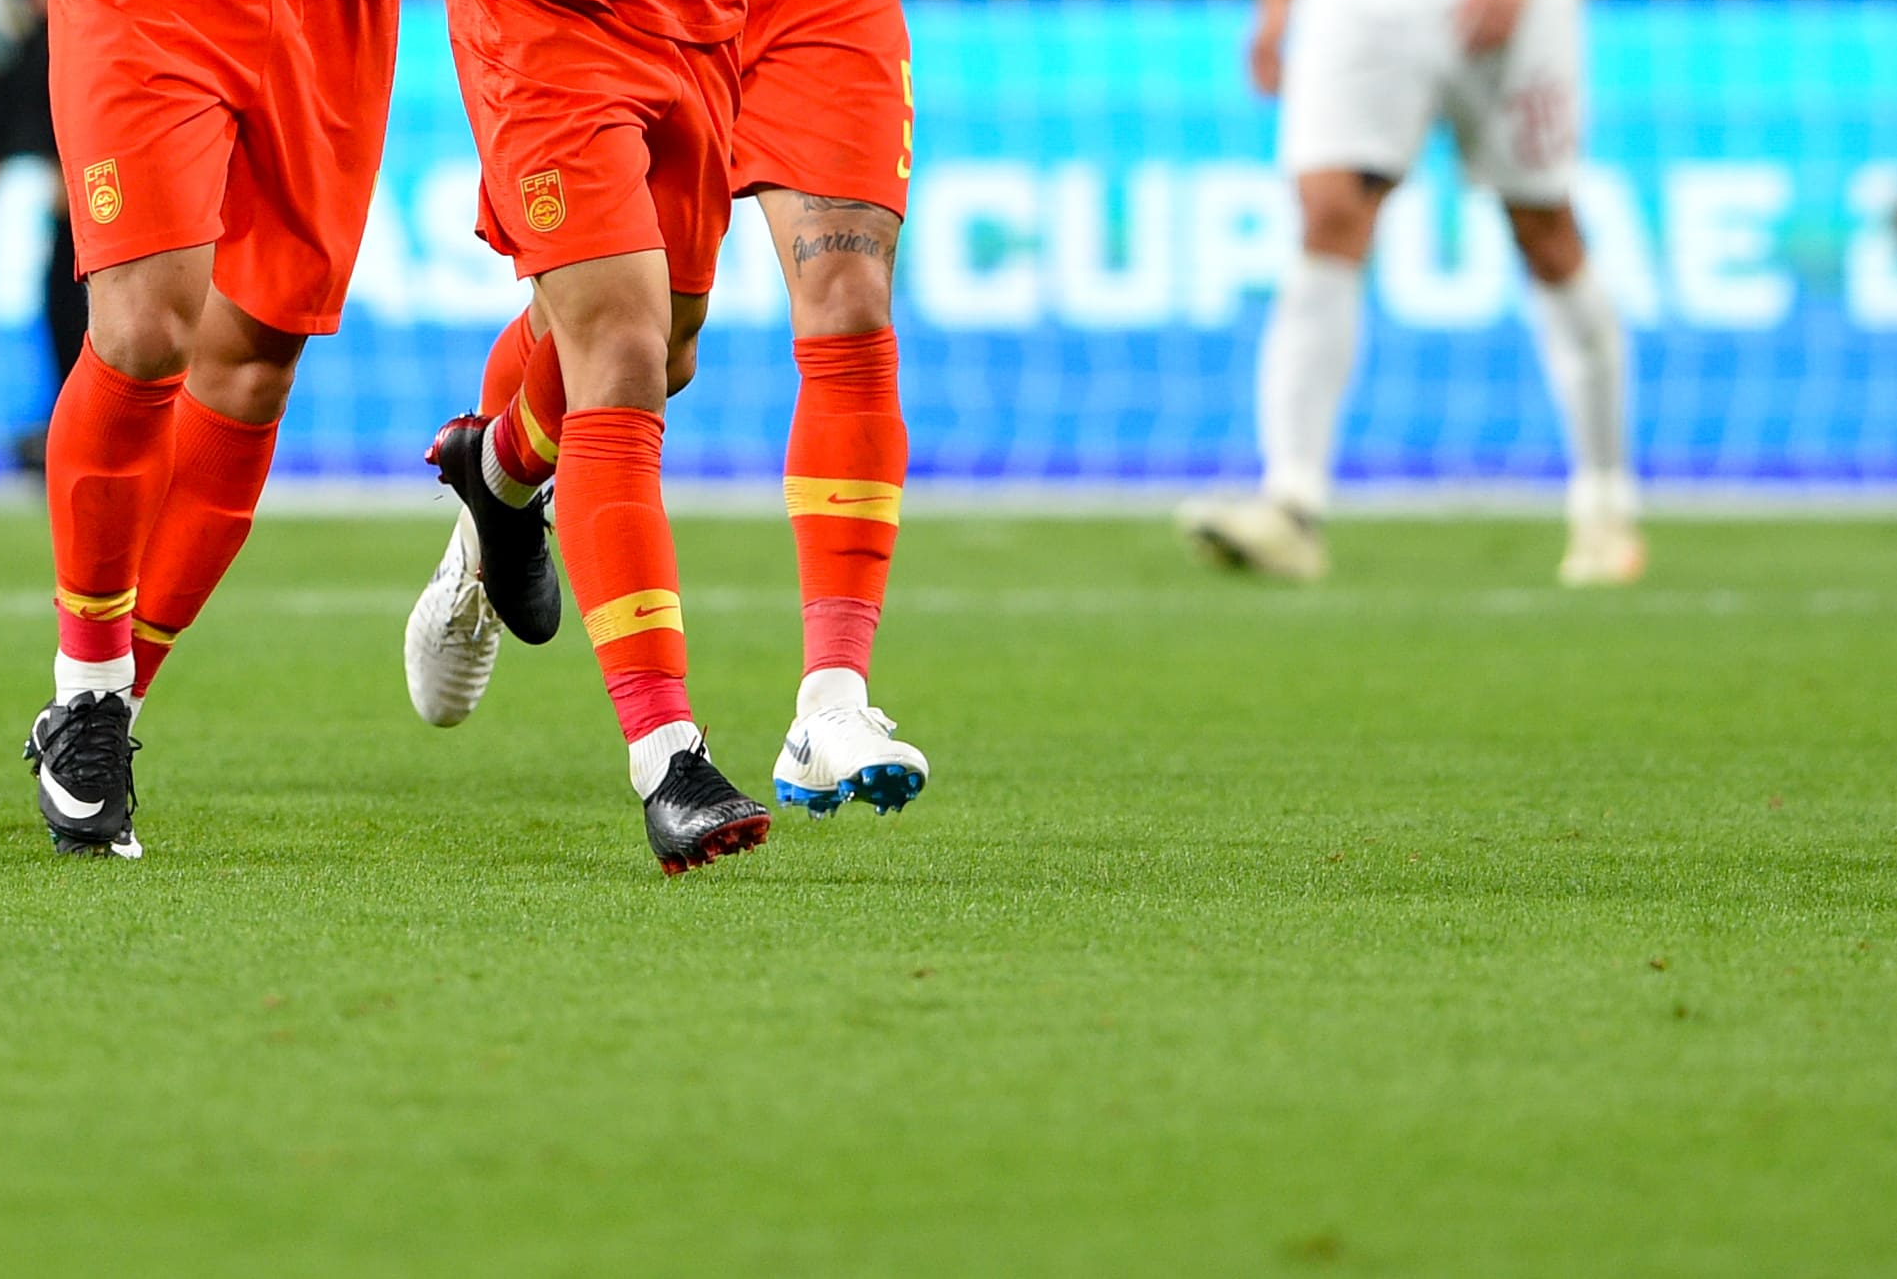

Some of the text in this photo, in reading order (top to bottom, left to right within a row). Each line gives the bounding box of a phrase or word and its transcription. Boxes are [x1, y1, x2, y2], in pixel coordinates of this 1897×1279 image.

[87, 163, 113, 182] CFA
[524, 174, 556, 192] CFA
[912, 159, 1296, 329] CUP
